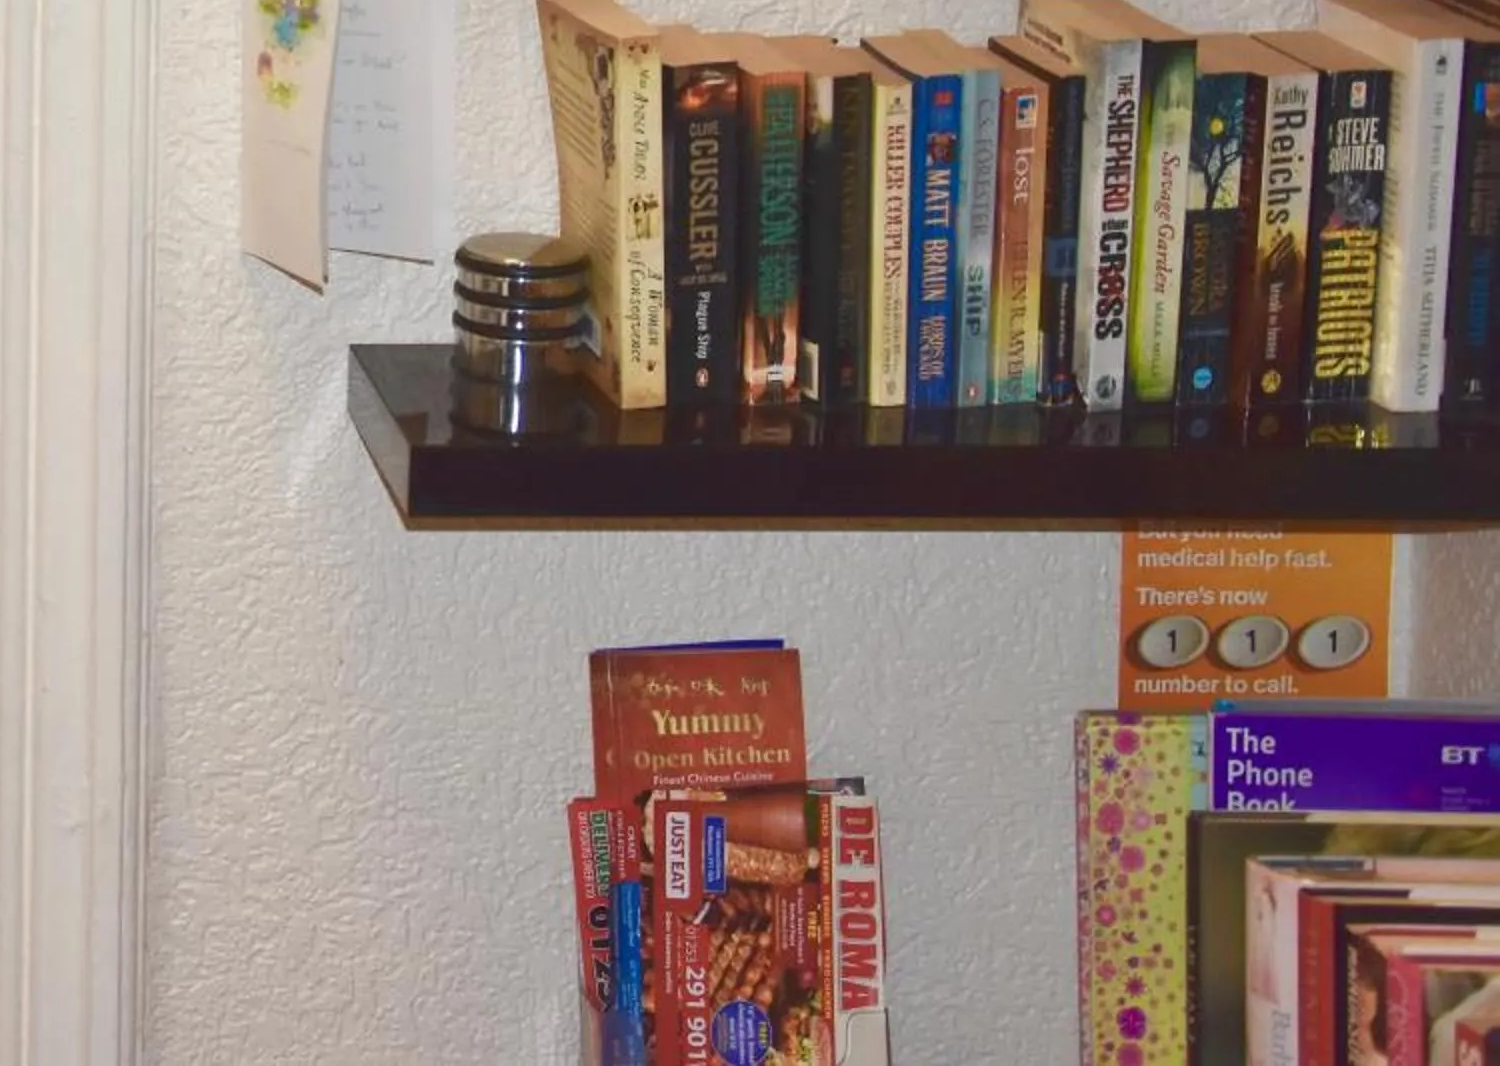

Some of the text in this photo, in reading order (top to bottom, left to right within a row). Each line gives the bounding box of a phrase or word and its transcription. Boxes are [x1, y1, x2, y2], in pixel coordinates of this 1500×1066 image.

[1117, 74, 1135, 99] THE
[1272, 82, 1309, 108] Kathy
[885, 124, 905, 190] KILLER
[1102, 99, 1136, 212] SHEPHERD
[1336, 117, 1380, 145] STEVE
[689, 137, 718, 262] CUSSLER
[759, 104, 799, 247] PATTERSON
[969, 138, 992, 238] FORESTER
[1012, 146, 1036, 206] lost
[1155, 151, 1181, 221] Savage
[1265, 108, 1309, 226] Reichs
[883, 195, 905, 279] COUPLES
[920, 169, 951, 302] MATT BRAUN
[1153, 223, 1176, 295] Garden
[1189, 222, 1208, 316] BROWN
[623, 267, 648, 364] Consequence
[966, 265, 986, 338] SHIP
[1095, 230, 1128, 341] CROSS
[1315, 228, 1378, 379] PATRIOTS
[695, 290, 711, 359] Plague Ship
[1413, 291, 1434, 397] SUTHERLAND
[1136, 548, 1332, 571] medical help fast.
[1136, 587, 1268, 606] There's now
[1166, 628, 1338, 653] 1 1 1
[1133, 675, 1299, 694] number to call.
[633, 745, 791, 772] Open Kitchen
[651, 709, 765, 740] Yummy
[1225, 727, 1277, 755] The
[1440, 745, 1485, 766] BT
[687, 772, 731, 785] Chinese
[733, 770, 774, 783] Cuisine
[1226, 759, 1314, 787] Phone
[1226, 791, 1297, 811] Book
[670, 817, 686, 894] JUST EAT
[837, 805, 879, 1012] DE ROMA
[684, 925, 707, 1066] 01253 291 901
